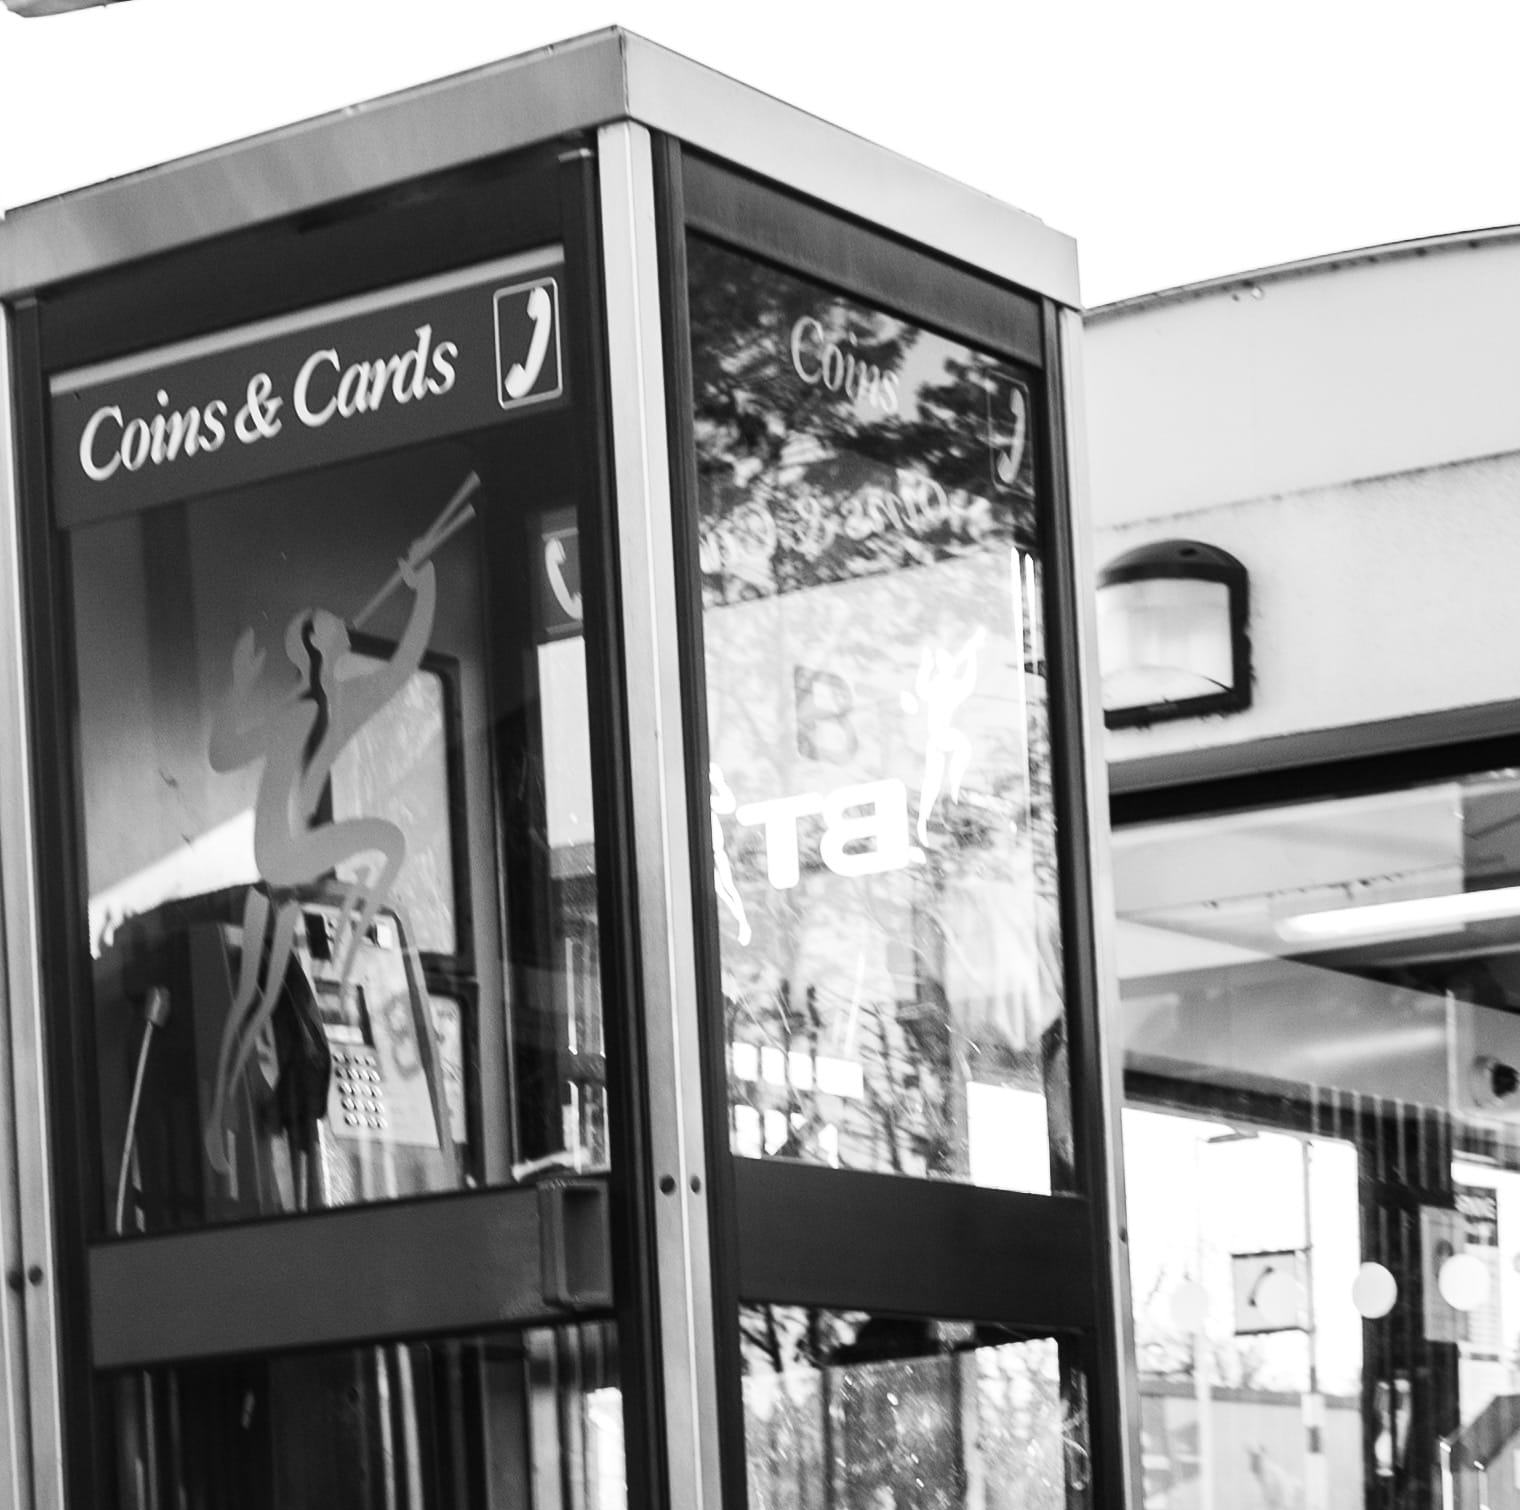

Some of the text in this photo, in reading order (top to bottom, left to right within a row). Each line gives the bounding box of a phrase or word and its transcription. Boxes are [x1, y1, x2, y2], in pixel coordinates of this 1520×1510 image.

[80, 324, 459, 482] Coins & Cards
[791, 316, 900, 416] Coins
